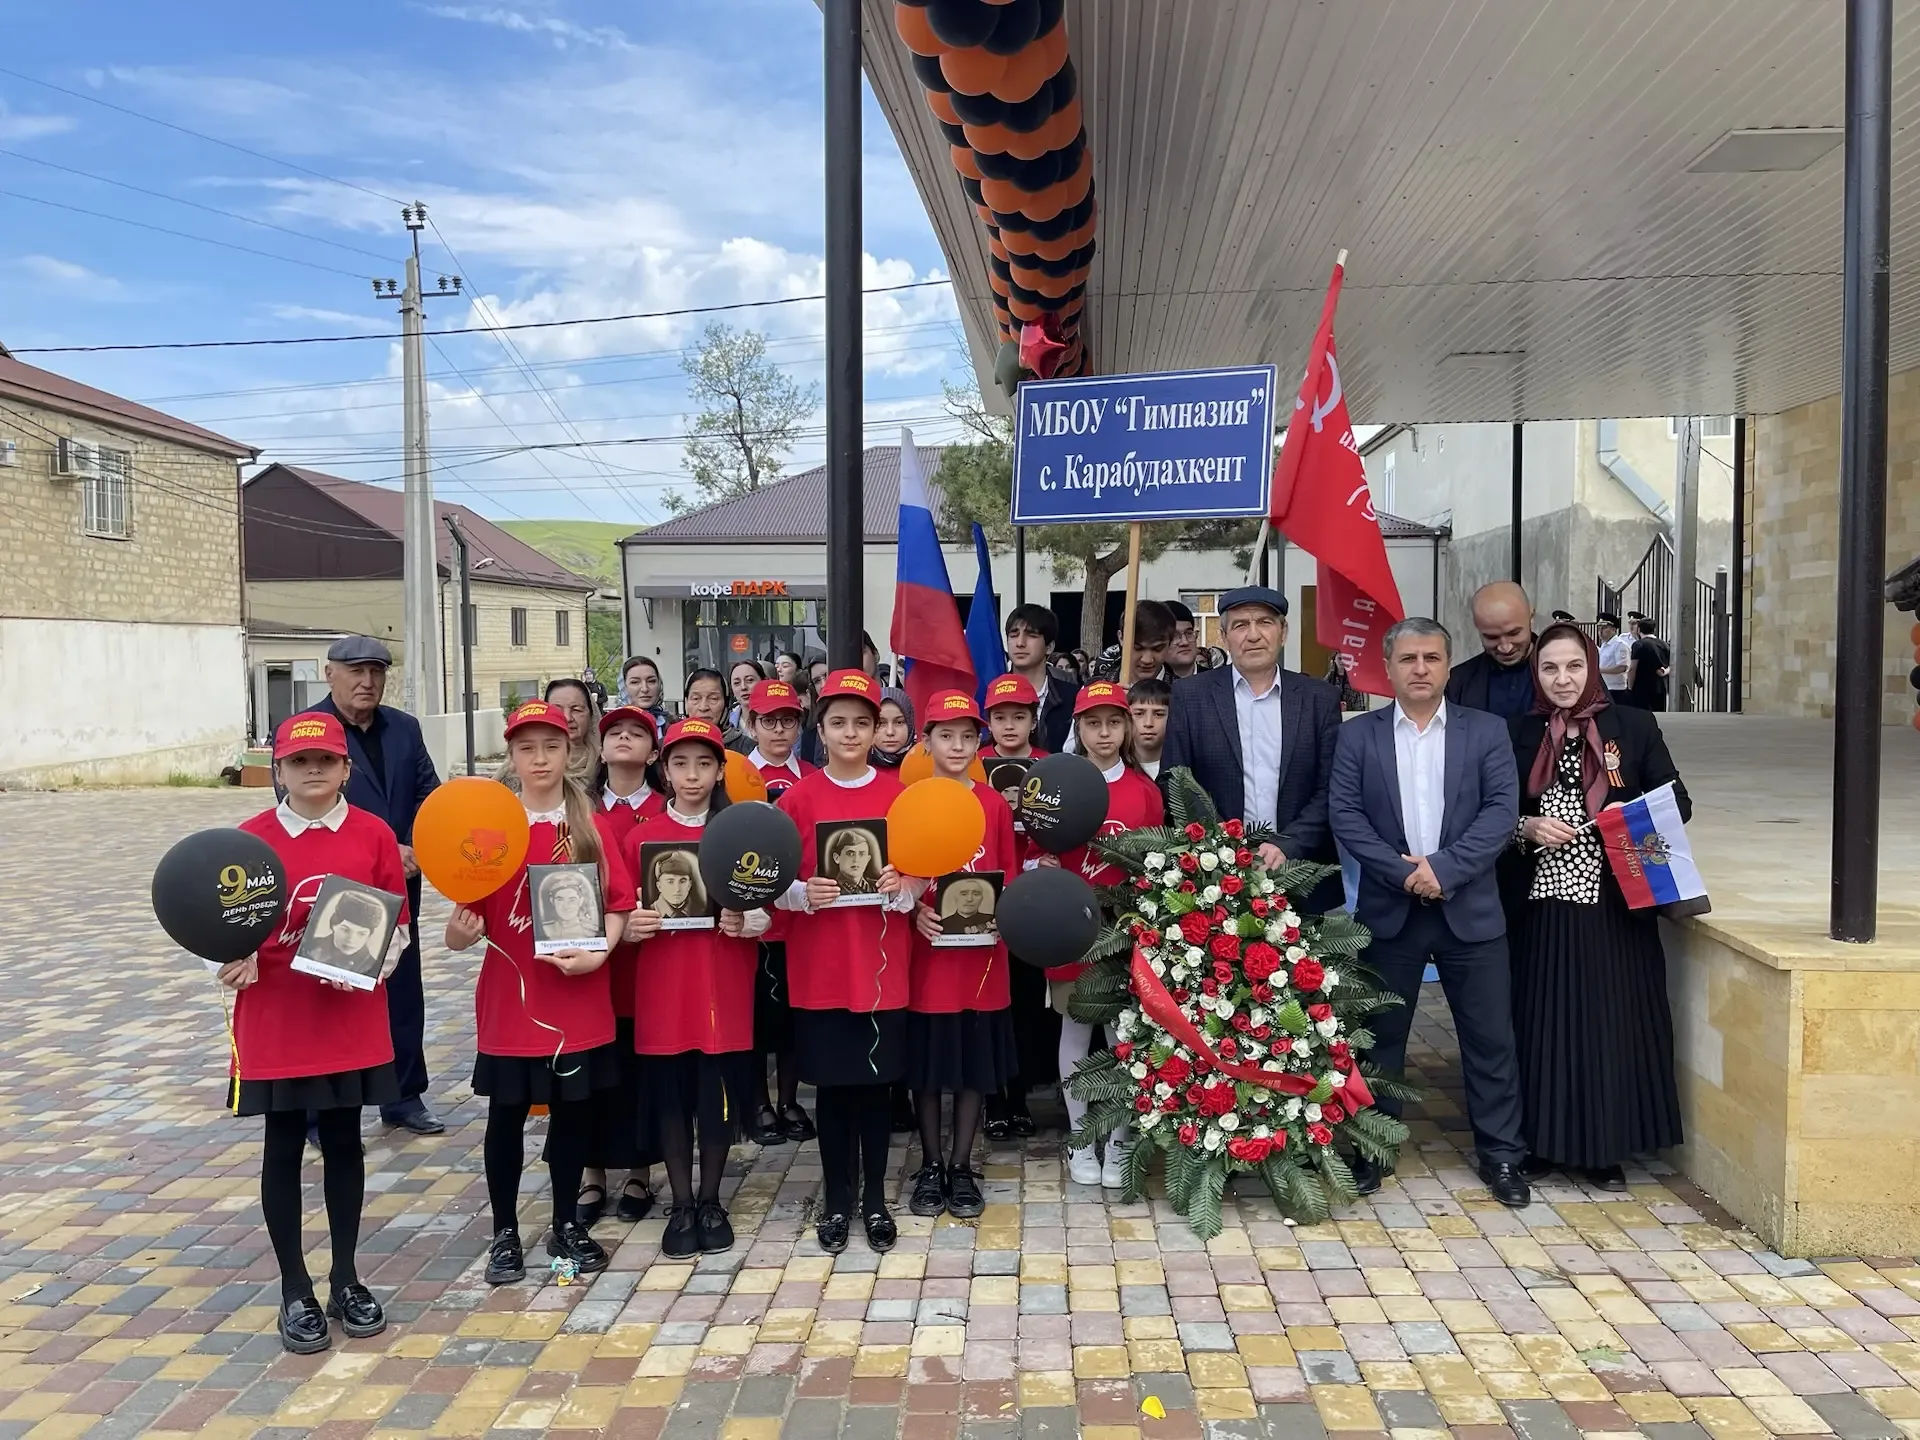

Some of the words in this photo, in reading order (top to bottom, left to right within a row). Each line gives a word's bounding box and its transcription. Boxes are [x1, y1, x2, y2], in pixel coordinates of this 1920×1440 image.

[1028, 397, 1109, 437] МБОУ
[1039, 464, 1057, 491] с.
[1063, 451, 1247, 498] Карабудахкент
[839, 680, 868, 692] ПОБЕДЫ
[944, 701, 969, 709] ПОБЕДЫ
[290, 727, 326, 740] ПОБЕДЫ
[1023, 777, 1042, 802] 9
[1035, 792, 1061, 806] МАЯ
[734, 851, 760, 880] 9
[754, 868, 779, 878] МАЯ
[220, 865, 247, 900] 9
[246, 875, 275, 889] МАЯ
[728, 880, 748, 890] ДЕНЬ
[222, 906, 248, 918] ДЕНЬ
[248, 900, 279, 911] ПОБЕДЫ
